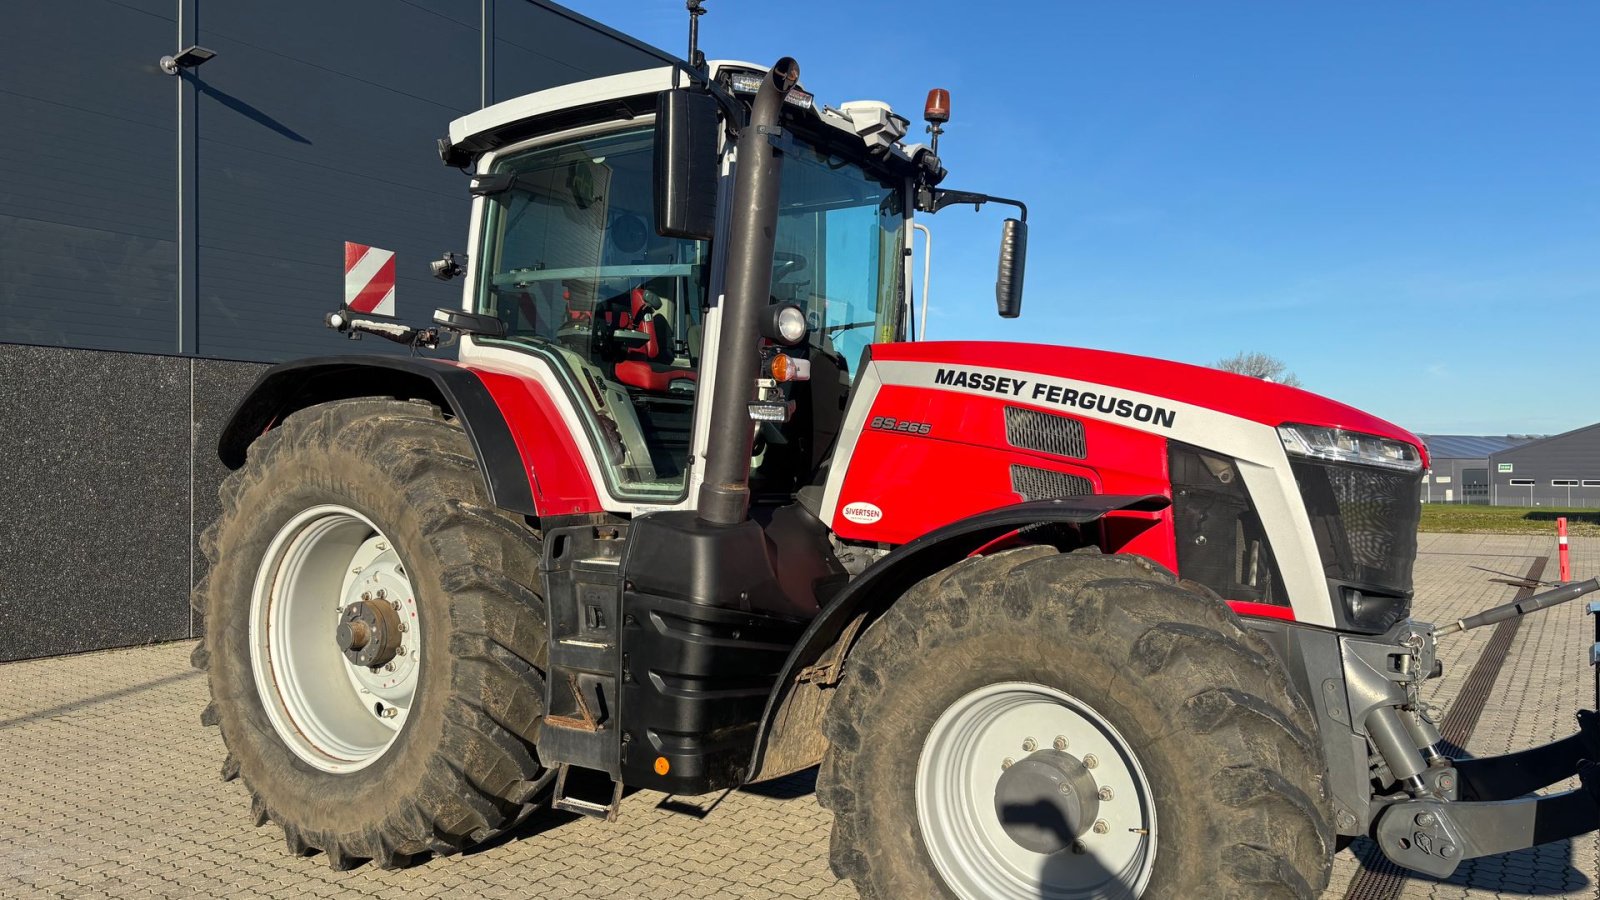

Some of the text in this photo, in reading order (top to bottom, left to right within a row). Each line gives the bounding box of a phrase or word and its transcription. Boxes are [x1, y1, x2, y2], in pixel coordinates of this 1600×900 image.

[935, 368, 1177, 428] MASSEY FERGUSON
[871, 416, 932, 434] 8S.265
[845, 507, 880, 518] SIVERTSEN
